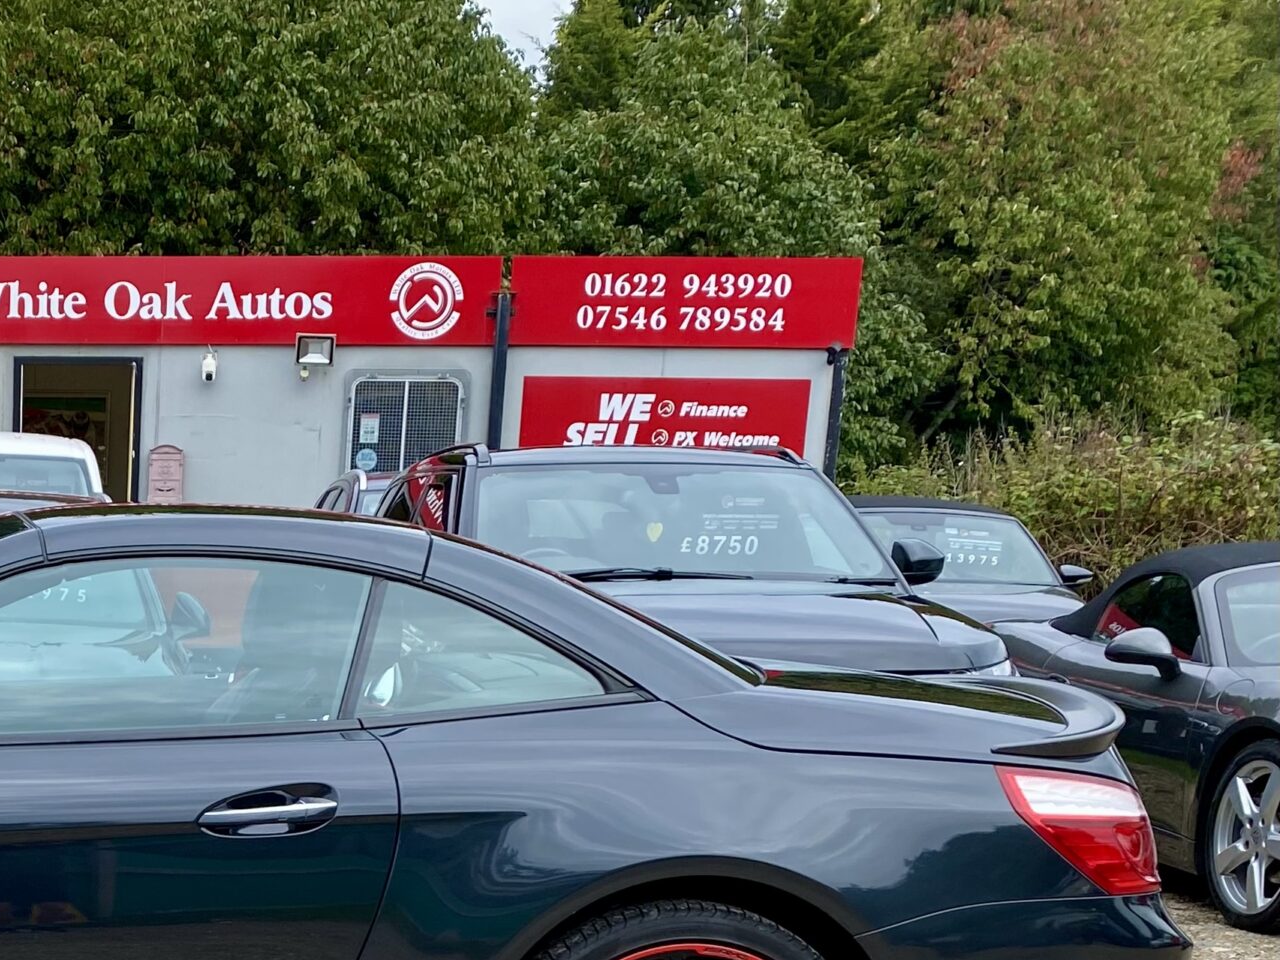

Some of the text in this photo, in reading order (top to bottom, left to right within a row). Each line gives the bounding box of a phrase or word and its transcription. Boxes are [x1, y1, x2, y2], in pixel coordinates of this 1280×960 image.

[584, 272, 792, 298] 01622 943920
[104, 280, 193, 321] Oak
[204, 282, 333, 320] Autos
[576, 305, 785, 332] 07546 789584
[598, 393, 657, 422] WE
[679, 401, 748, 418] Finance
[672, 431, 780, 447] PX Welcome
[680, 535, 759, 555] £8750
[28, 587, 87, 603] 975
